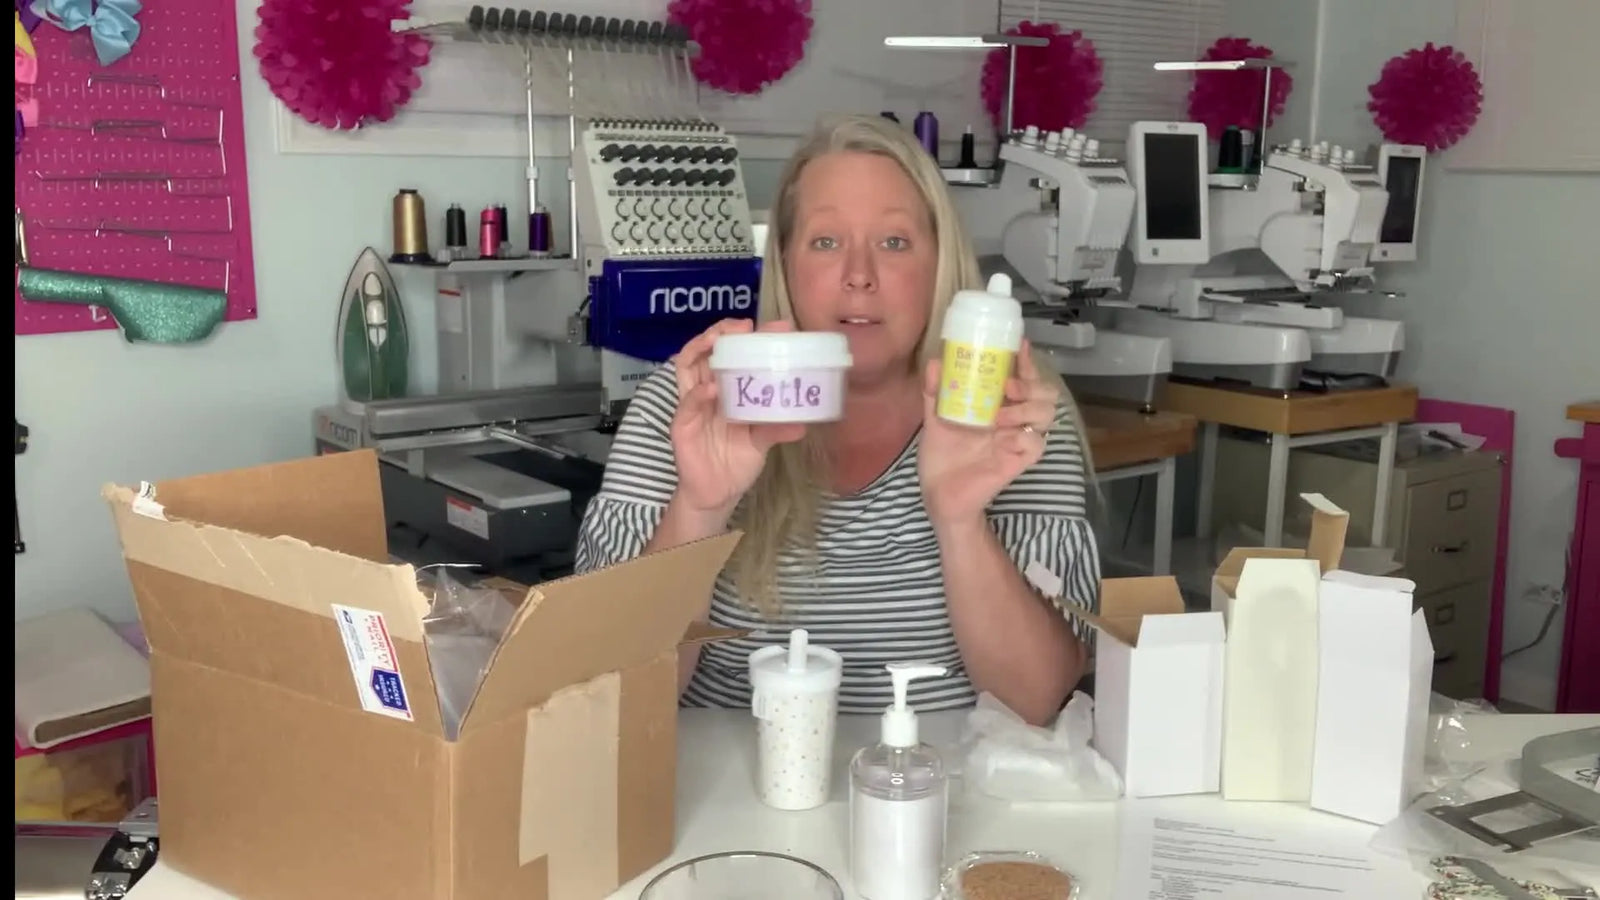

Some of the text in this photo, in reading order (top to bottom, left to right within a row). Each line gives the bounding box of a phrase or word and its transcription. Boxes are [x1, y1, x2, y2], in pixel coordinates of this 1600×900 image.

[650, 285, 752, 314] ricoma
[736, 374, 821, 407] Katie
[368, 614, 391, 666] PRIORITY
[389, 677, 402, 706] TRACKED
